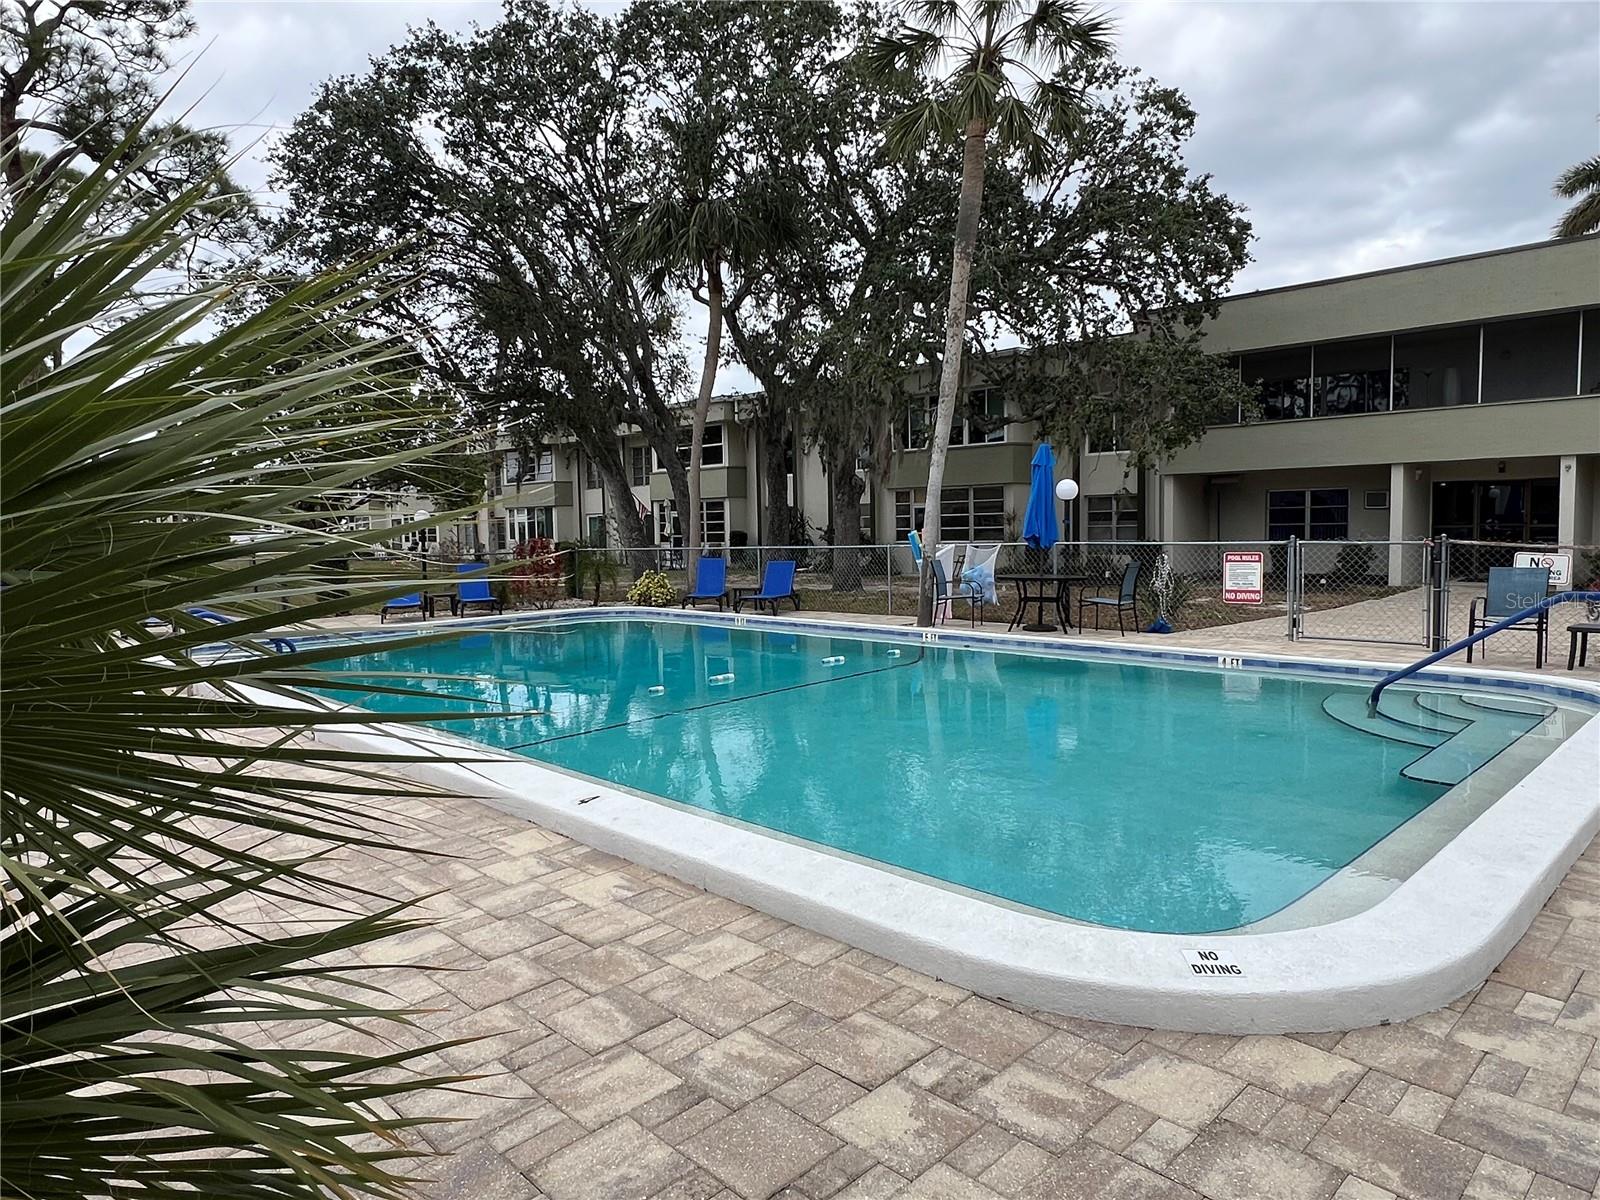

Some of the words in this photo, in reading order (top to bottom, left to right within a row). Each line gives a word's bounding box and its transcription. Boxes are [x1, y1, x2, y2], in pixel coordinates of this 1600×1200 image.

[1225, 592, 1236, 600] NO
[1236, 592, 1260, 600] DIVING
[1197, 951, 1219, 961] NO
[1191, 963, 1242, 975] DIVING
